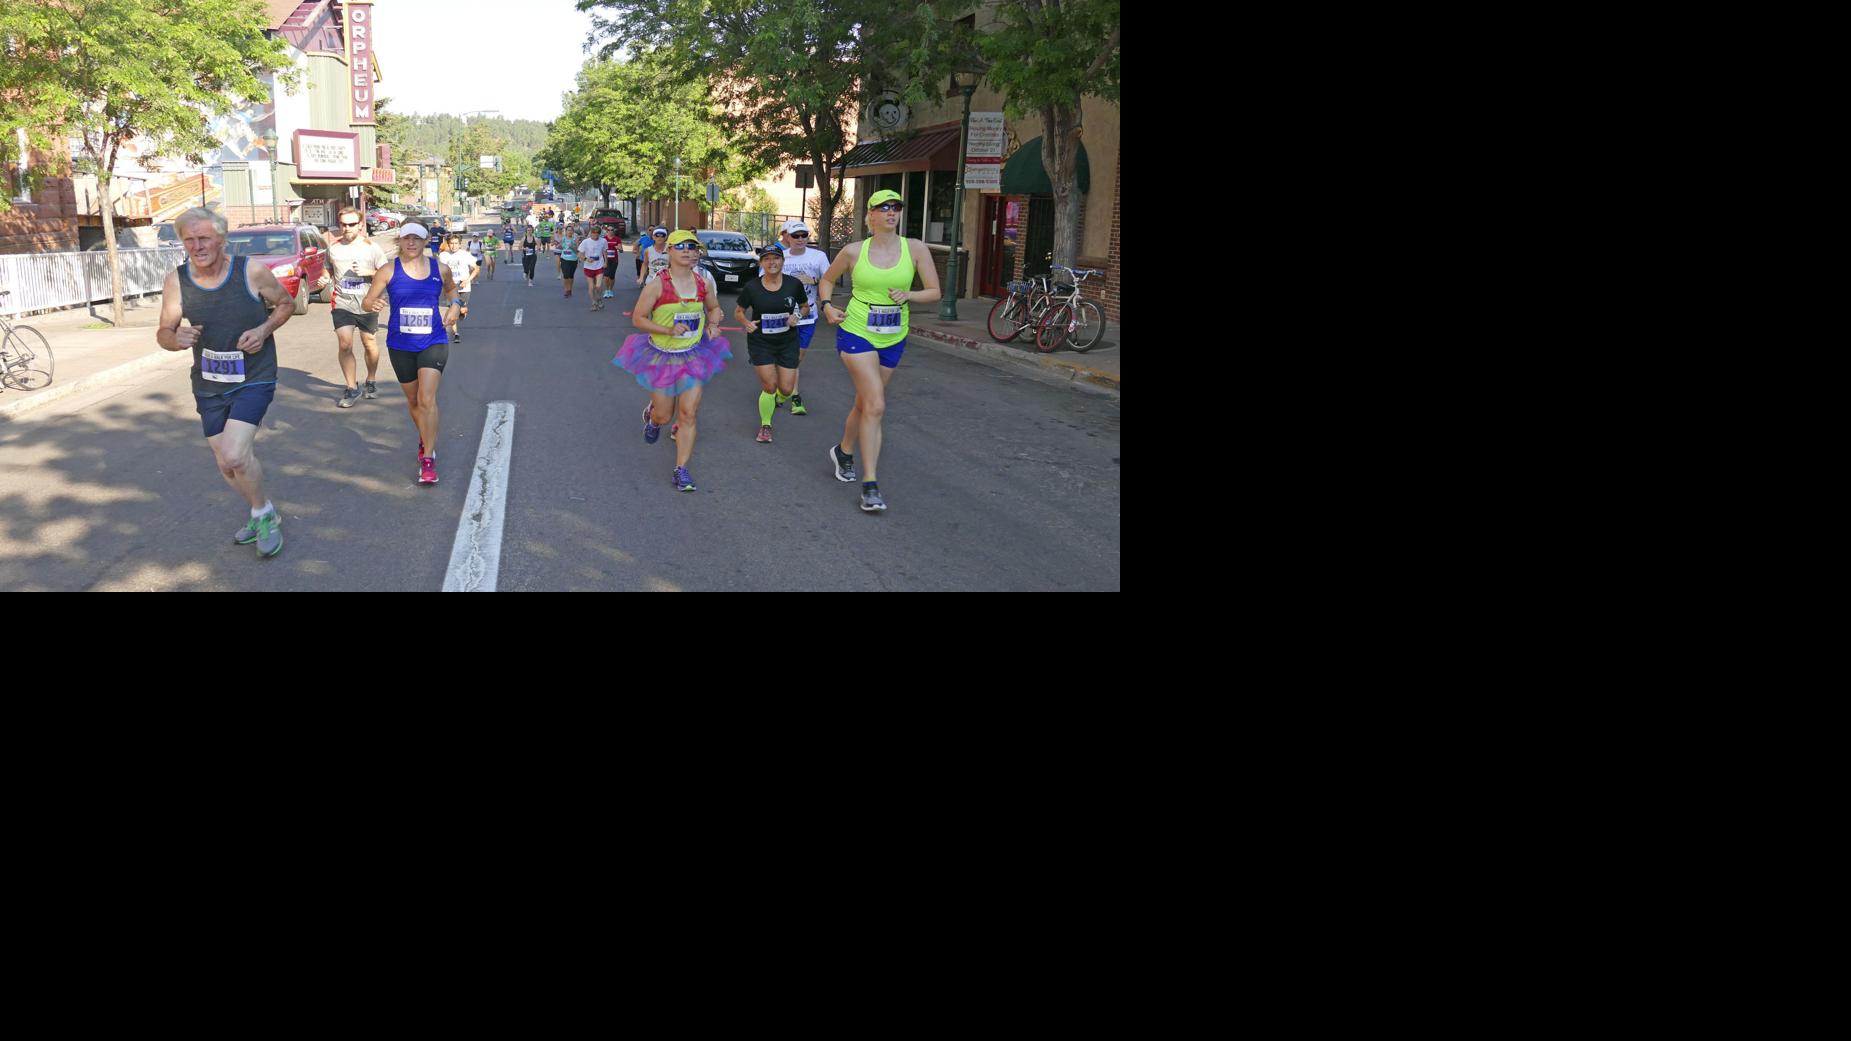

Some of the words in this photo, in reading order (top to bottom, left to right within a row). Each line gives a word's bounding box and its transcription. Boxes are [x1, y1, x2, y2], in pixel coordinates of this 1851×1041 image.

[351, 9, 369, 118] ORPHEUM
[403, 314, 429, 327] 1265
[872, 313, 900, 326] 1164
[207, 359, 237, 375] 1291
